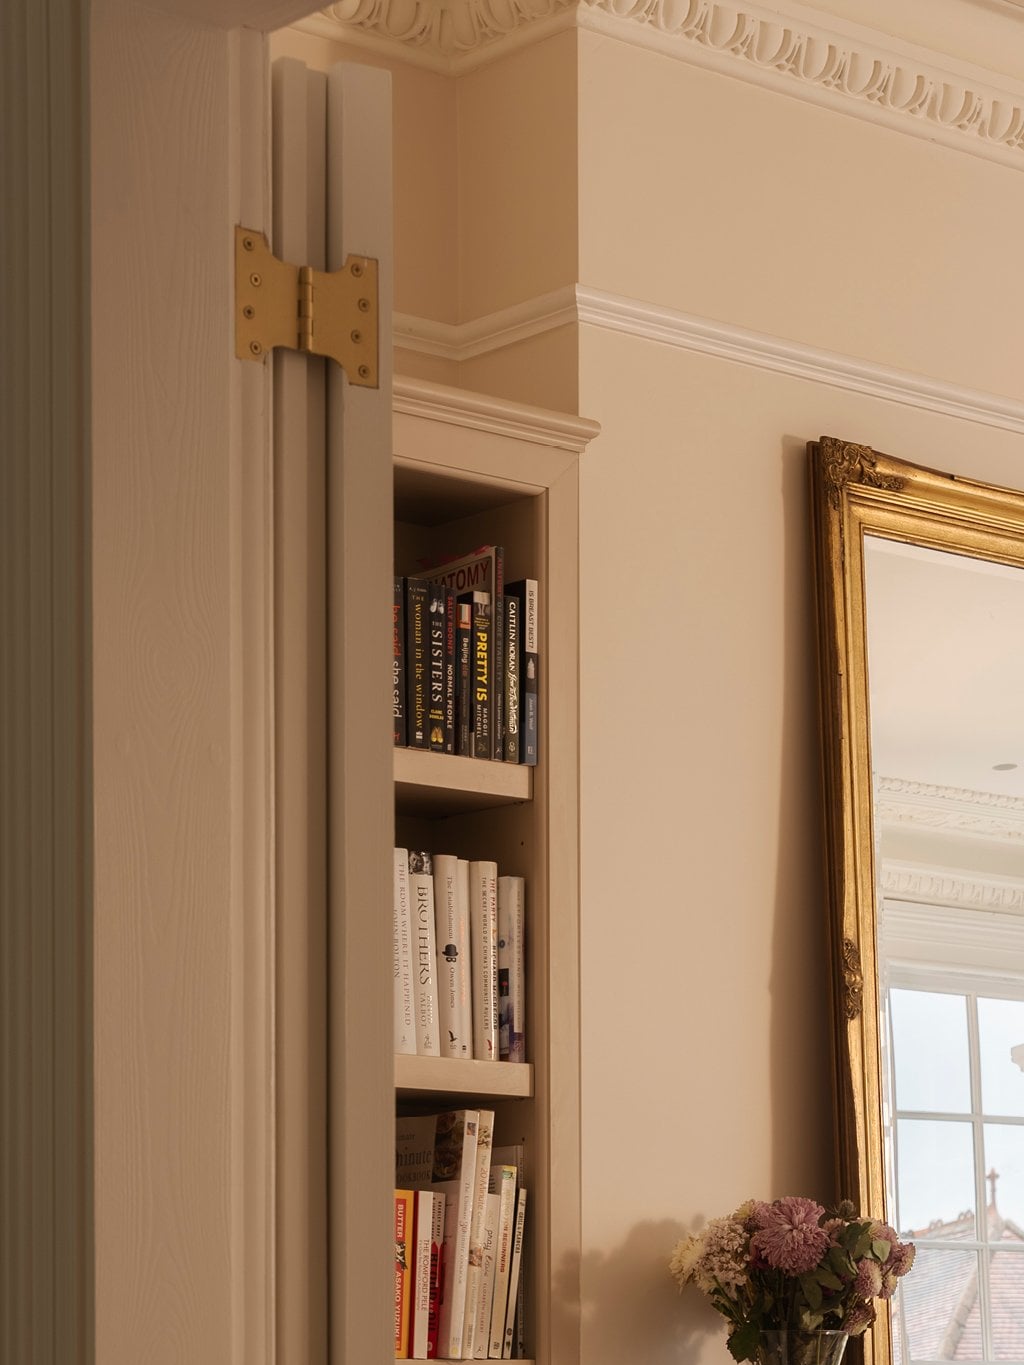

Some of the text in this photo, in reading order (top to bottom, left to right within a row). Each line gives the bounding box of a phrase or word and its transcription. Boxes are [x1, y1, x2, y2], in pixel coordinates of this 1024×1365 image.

[415, 604, 423, 644] woman
[527, 599, 535, 625] BREAST
[461, 637, 470, 664] Beijing
[508, 602, 517, 671] CAITLIN MORAN
[527, 627, 535, 649] BEST?
[415, 648, 424, 659] in
[431, 629, 443, 703] SISTERS
[476, 632, 489, 685] PRETTY
[392, 661, 403, 685] she
[415, 663, 425, 680] the
[392, 689, 403, 718] said
[415, 684, 425, 729] window
[446, 664, 454, 729] NORMAL PEOPLE
[476, 687, 489, 702] IS
[399, 883, 407, 917] ROOM
[447, 890, 455, 939] Establishment
[417, 886, 431, 986] BROTHERS
[402, 958, 410, 969] IT
[403, 972, 412, 1026] HAPPENED
[422, 1239, 430, 1251] THE
[483, 1229, 494, 1251] pray
[500, 1232, 509, 1273] BEGINNERS
